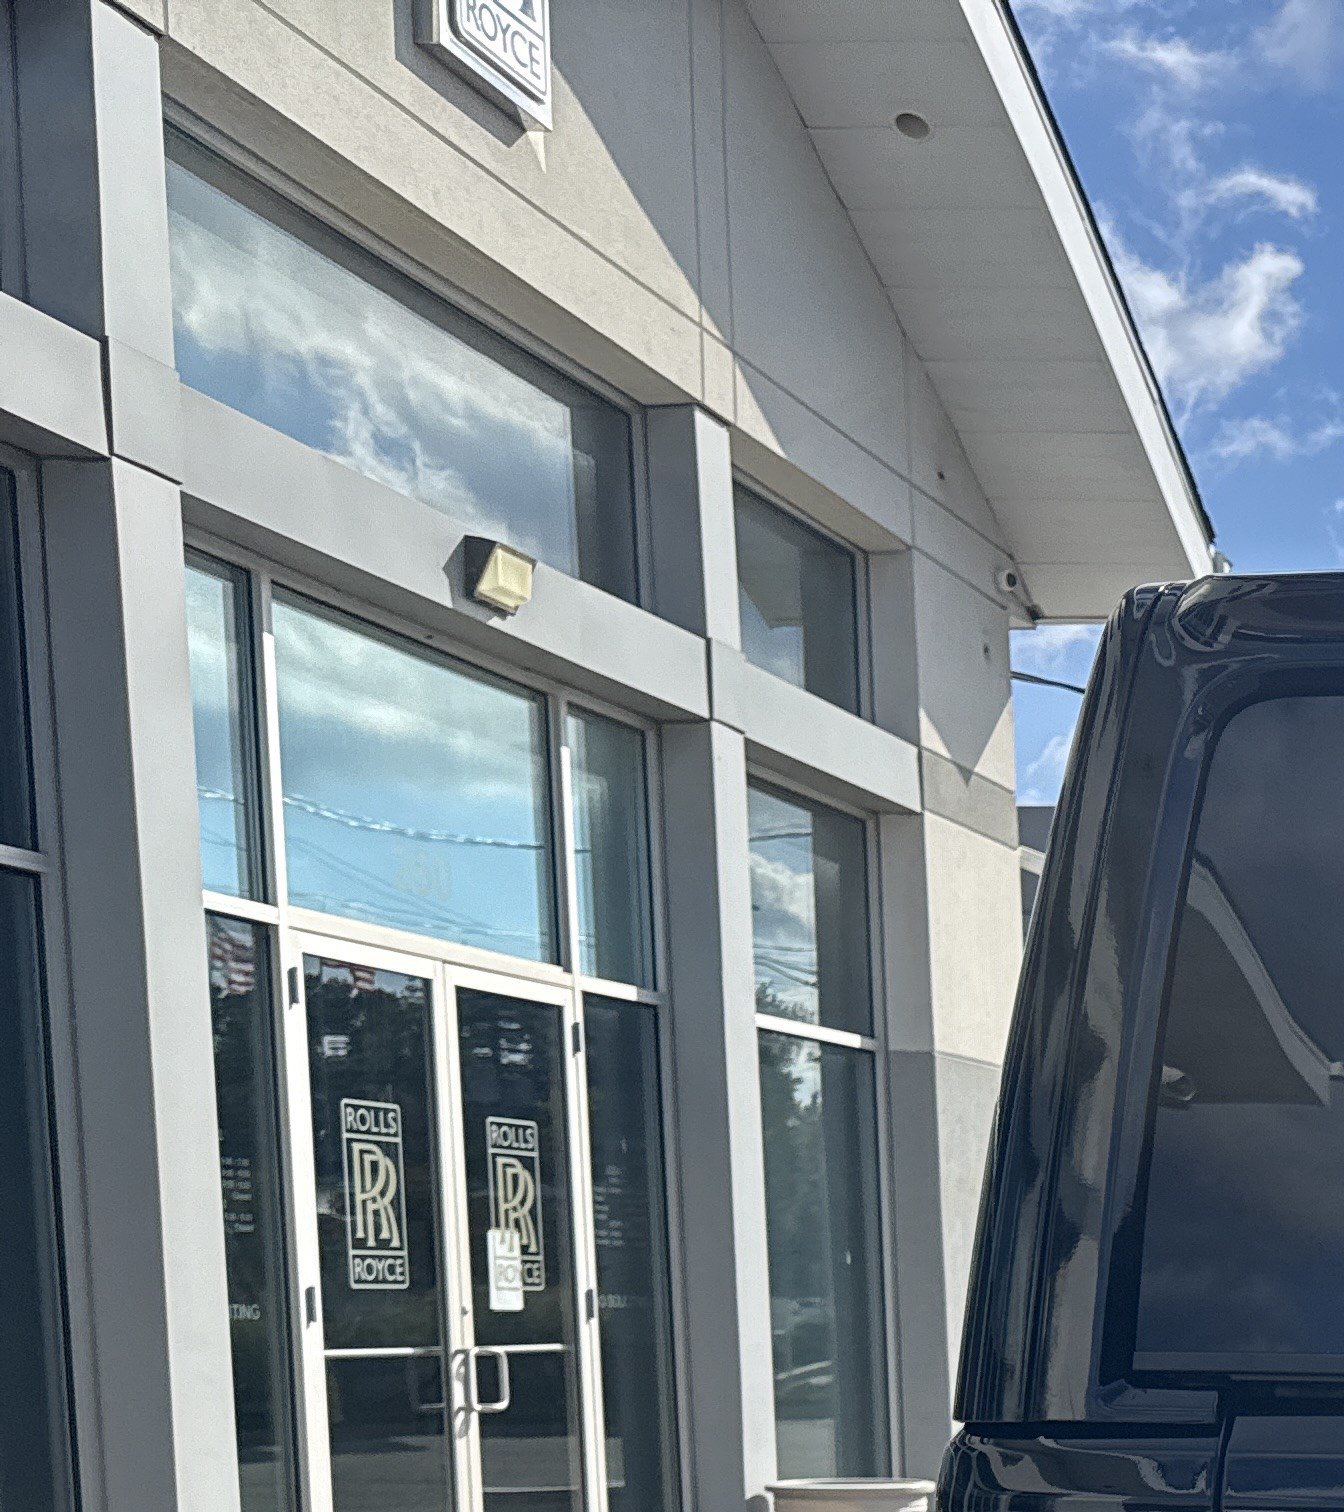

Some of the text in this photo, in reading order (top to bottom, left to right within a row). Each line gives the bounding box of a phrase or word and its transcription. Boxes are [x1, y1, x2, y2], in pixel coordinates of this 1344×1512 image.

[466, 0, 542, 80] ROYCE
[345, 1106, 398, 1135] ROLLS
[490, 1123, 536, 1150] ROLLS
[351, 1141, 401, 1248] RR
[353, 1257, 406, 1282] ROYCE
